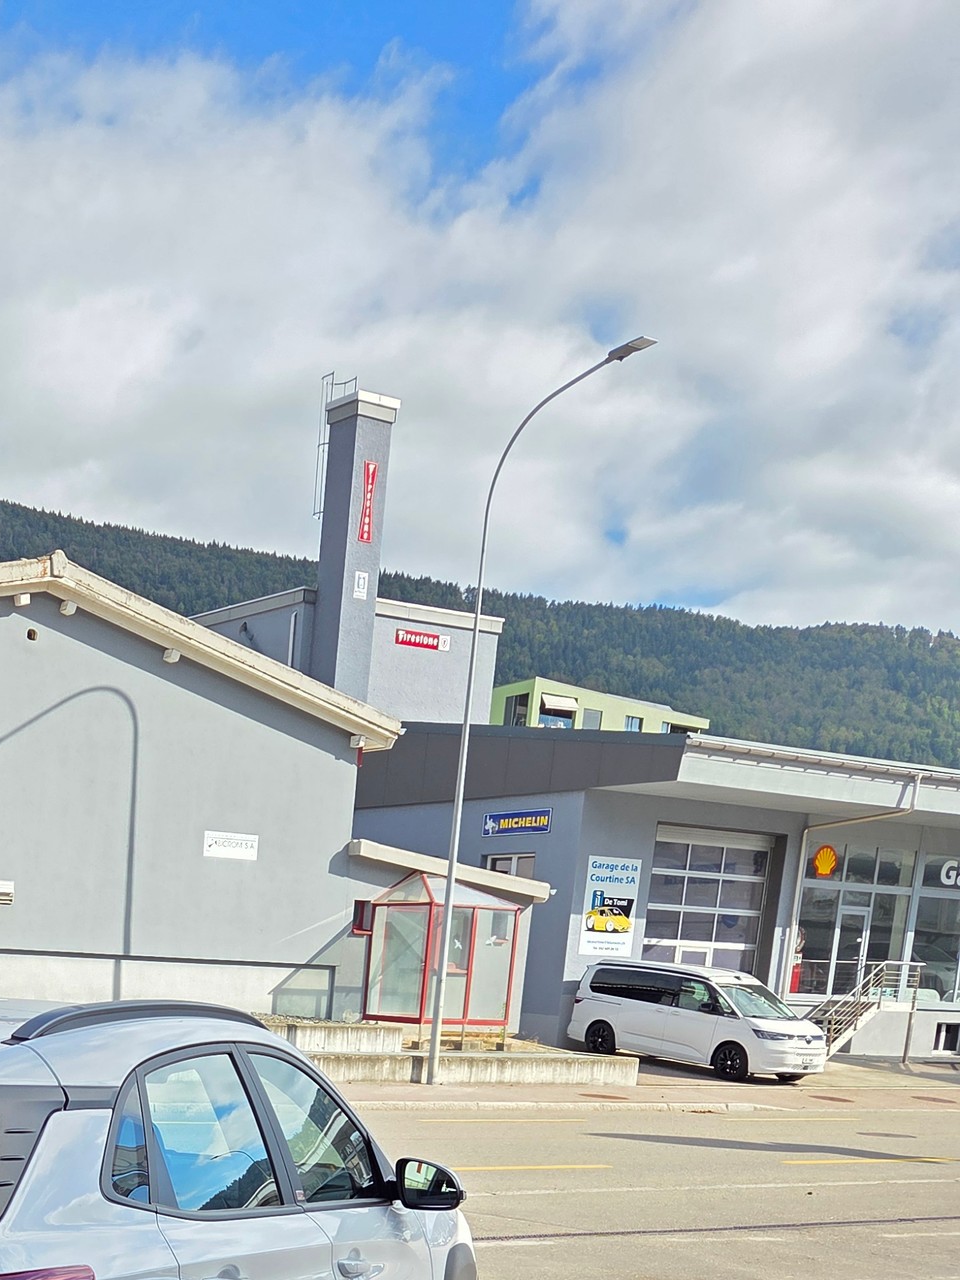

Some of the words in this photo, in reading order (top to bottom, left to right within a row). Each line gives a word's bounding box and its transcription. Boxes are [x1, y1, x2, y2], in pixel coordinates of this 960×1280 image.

[363, 464, 376, 540] Firestone
[398, 630, 439, 646] Firestone
[500, 816, 549, 829] MICHELIN
[591, 861, 619, 872] Garage
[620, 863, 630, 871] de
[631, 864, 638, 872] la
[590, 874, 624, 884] Courtine
[625, 876, 636, 884] SA
[604, 898, 613, 906] De
